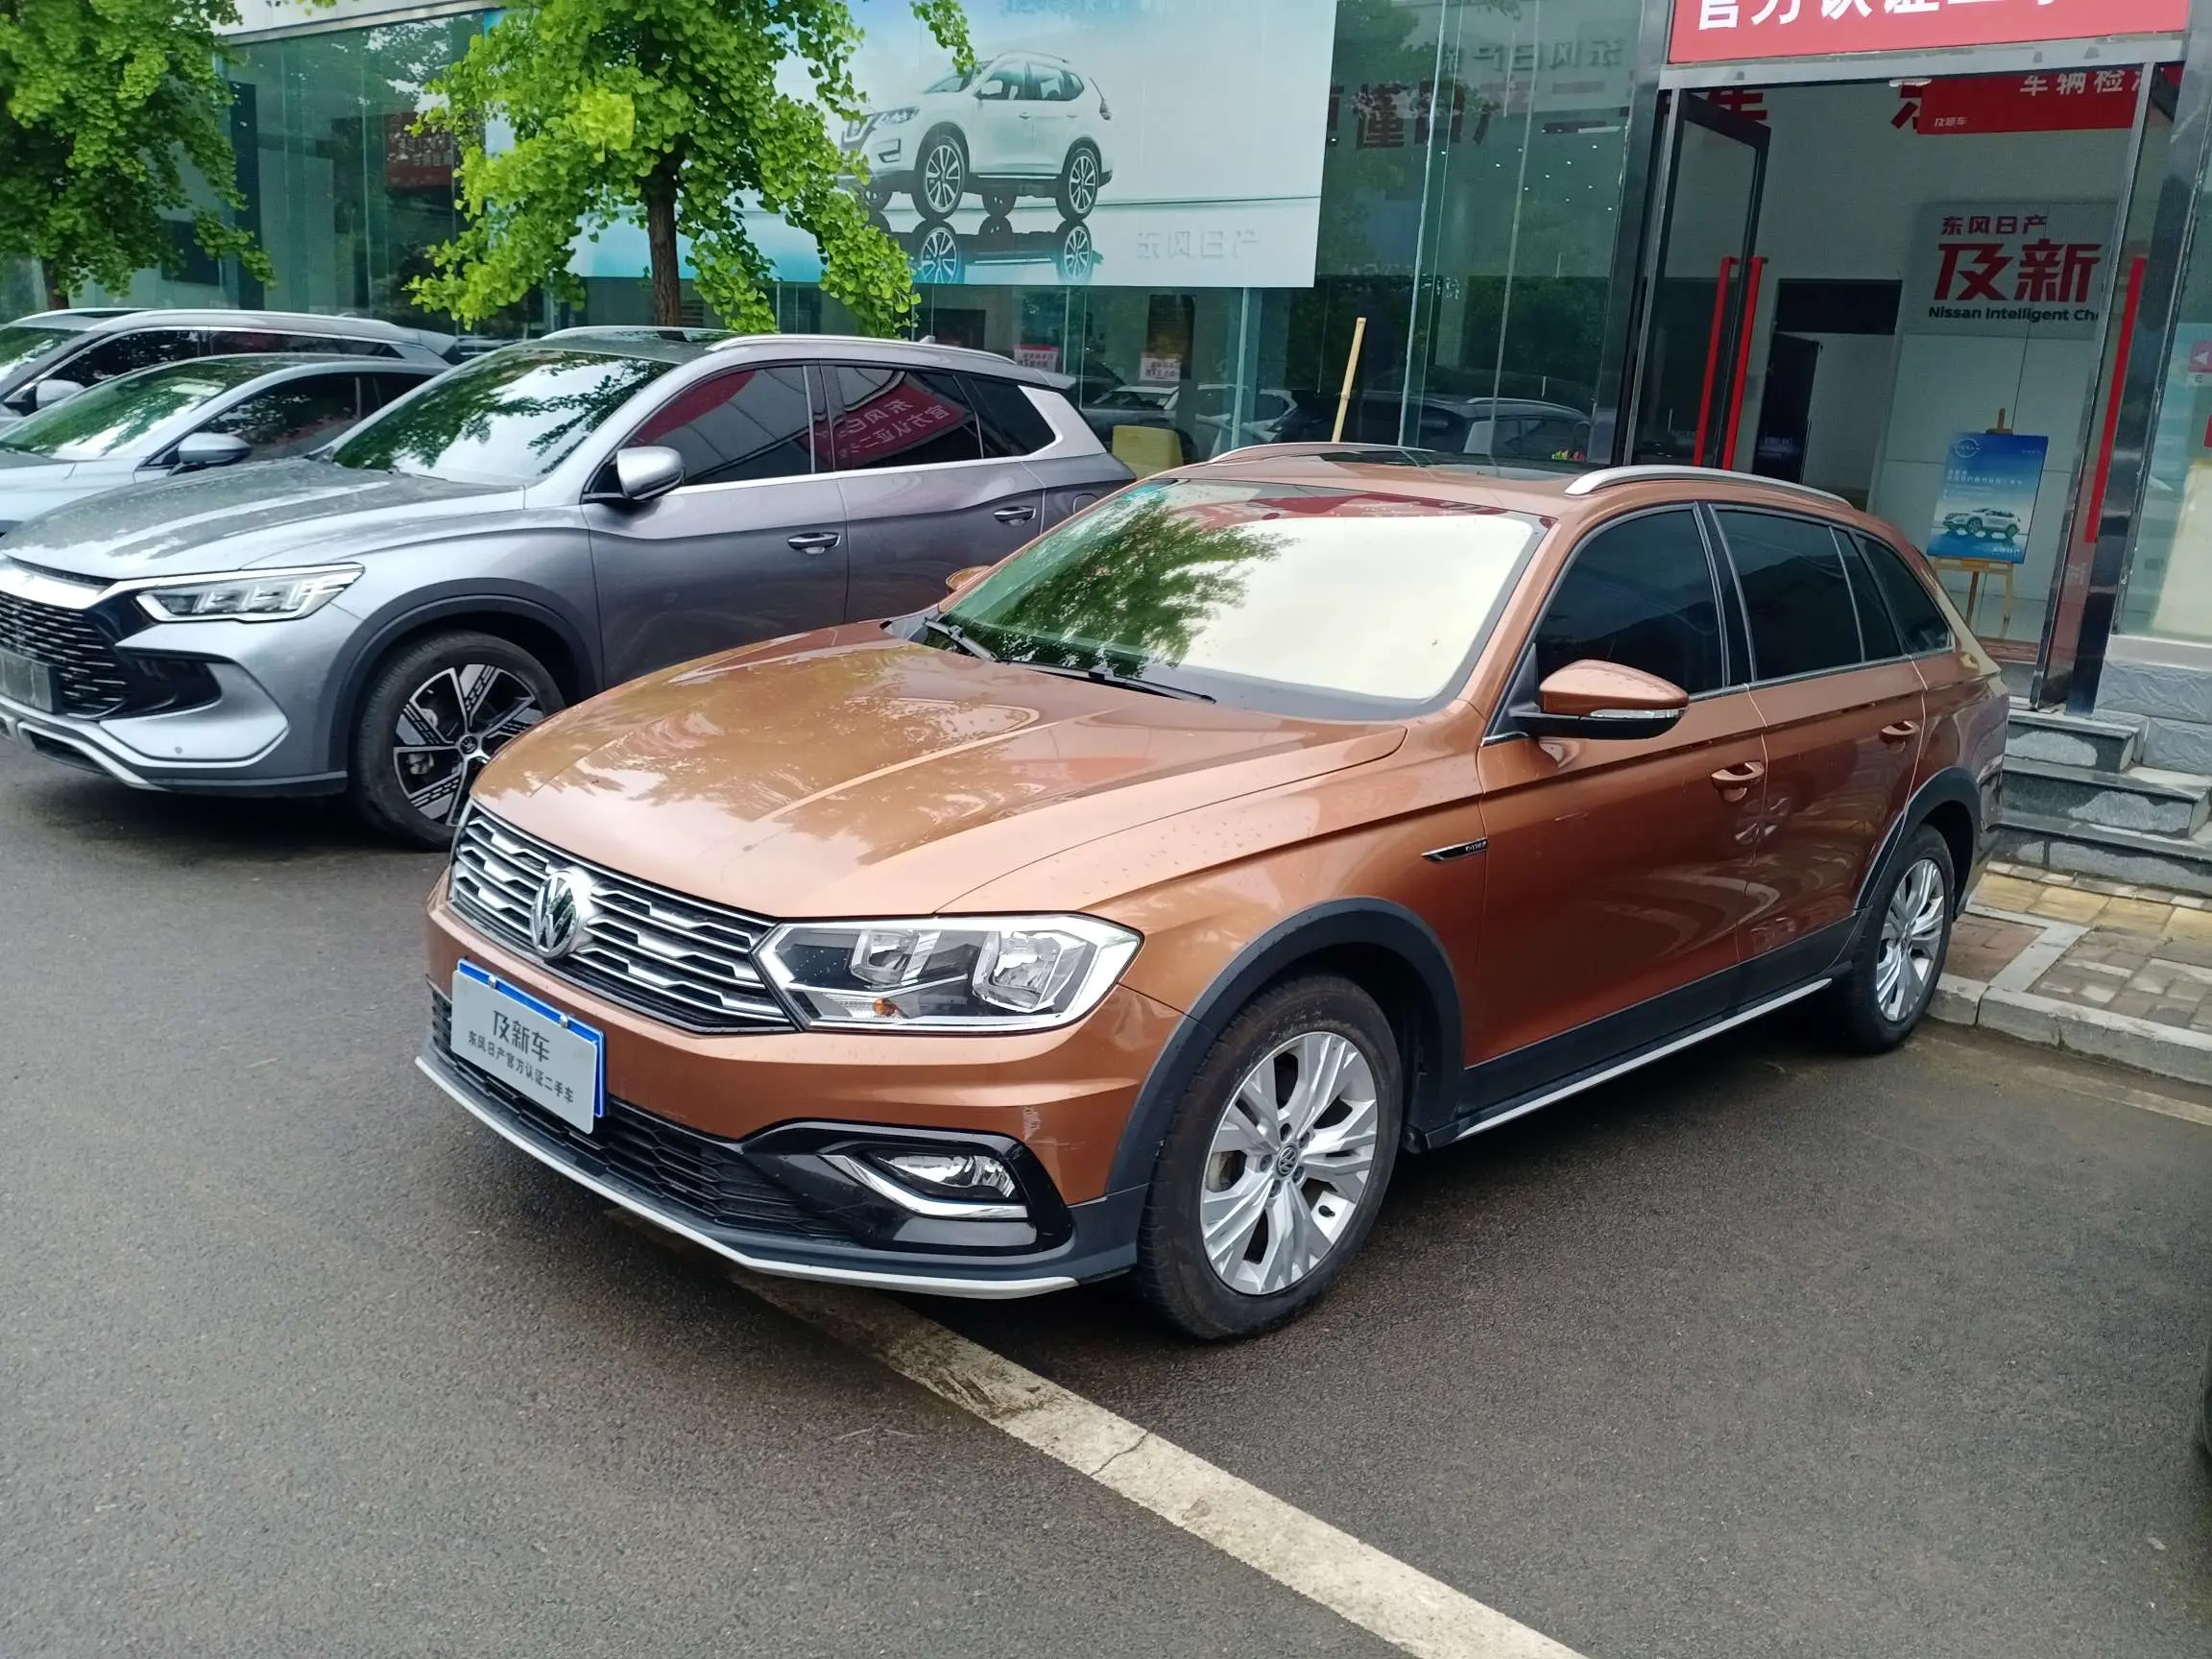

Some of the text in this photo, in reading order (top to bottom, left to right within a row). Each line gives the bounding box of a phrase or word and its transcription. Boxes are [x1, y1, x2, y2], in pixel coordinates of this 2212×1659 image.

[2020, 70, 2143, 97] 车辆检
[1941, 214, 2048, 235] 东风日产
[1934, 238, 2102, 302] 及新
[1928, 306, 1982, 320] Nissan
[1985, 306, 2070, 323] Intelligent
[493, 1010, 551, 1062] 及新车
[468, 1030, 574, 1103] 东风日产官方认证二手车
